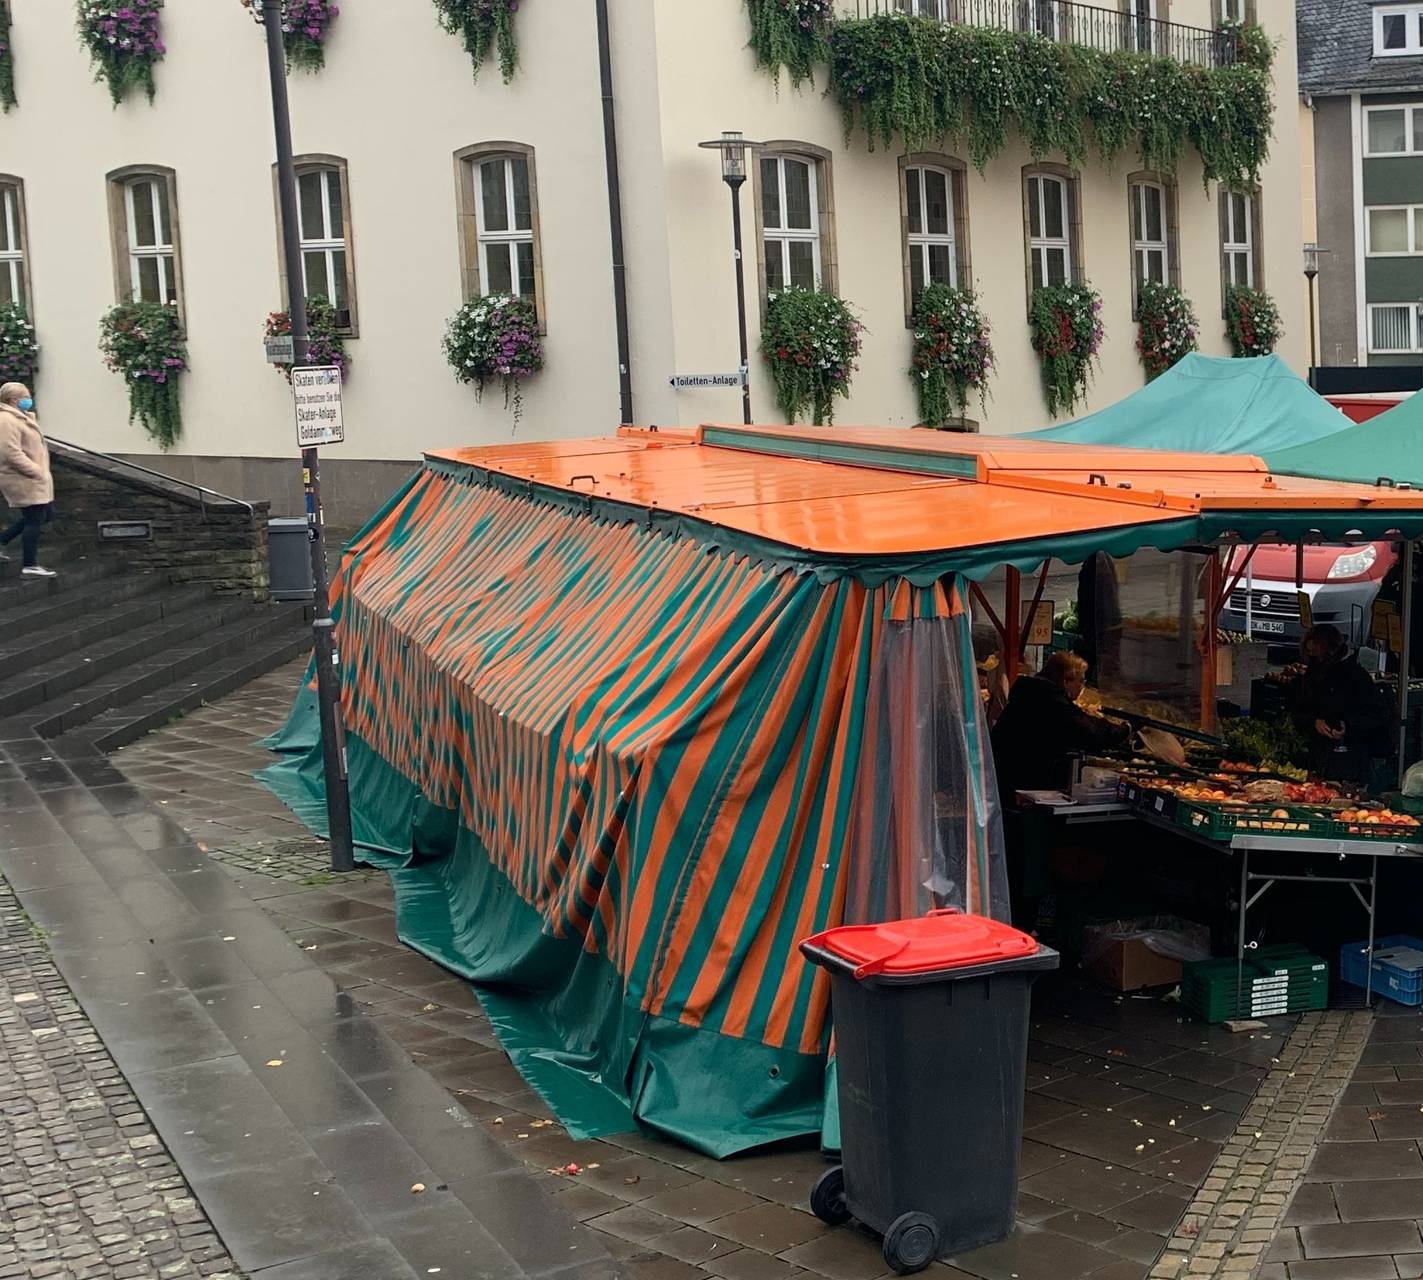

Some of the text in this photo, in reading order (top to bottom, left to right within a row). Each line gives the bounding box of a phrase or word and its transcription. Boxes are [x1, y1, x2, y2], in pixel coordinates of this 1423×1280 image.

[295, 373, 314, 386] Skaten
[676, 375, 738, 386] Toiletten-Anlage
[298, 407, 336, 422] Skater-Anlage
